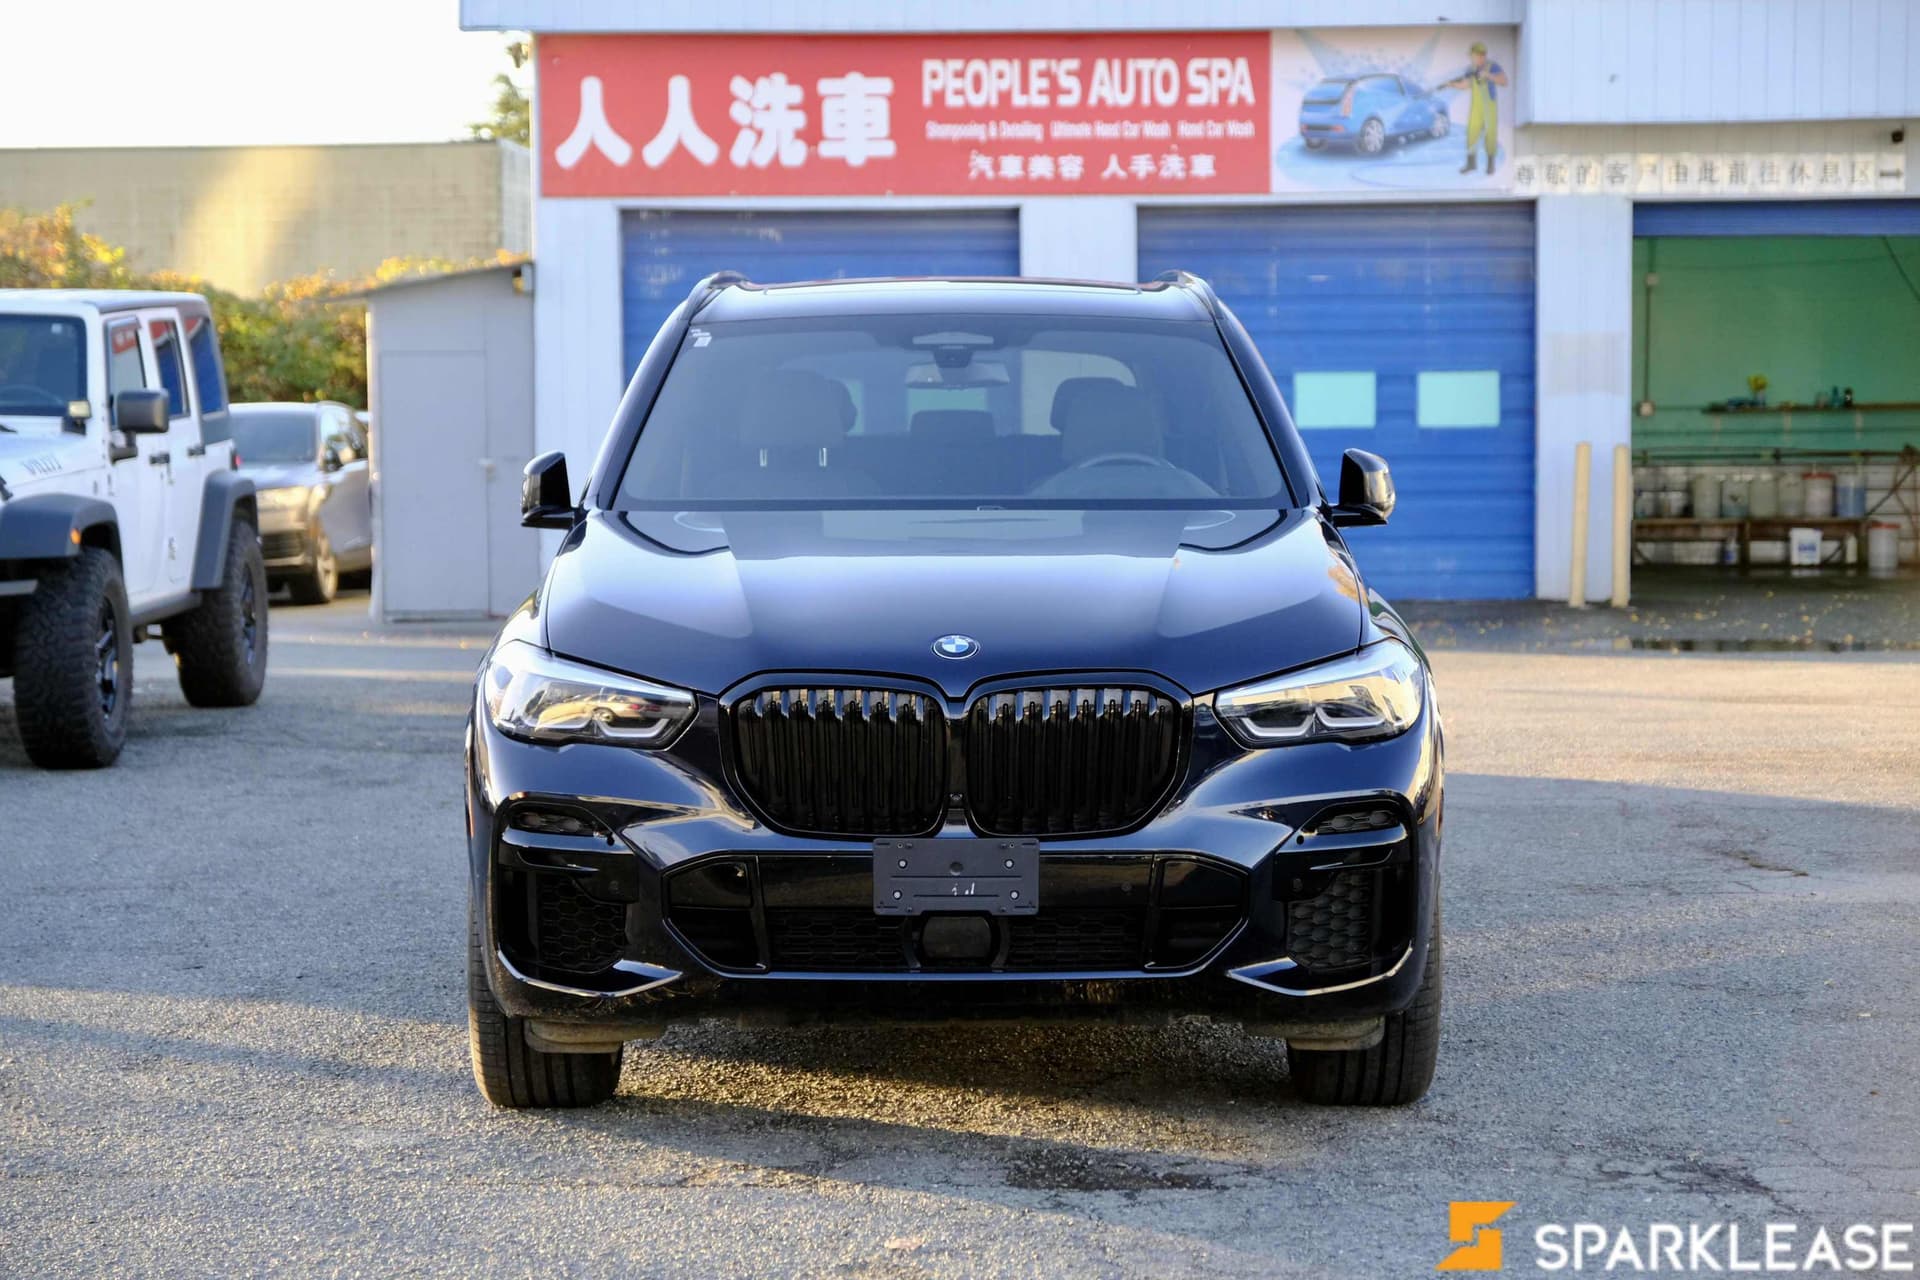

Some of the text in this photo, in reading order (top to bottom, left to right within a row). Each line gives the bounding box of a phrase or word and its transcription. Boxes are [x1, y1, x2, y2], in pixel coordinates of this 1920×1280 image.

[922, 57, 1256, 107] PEOPLE'S AUTO SPA
[555, 73, 896, 169] 人人洗車
[1123, 120, 1141, 139] Car
[1143, 120, 1171, 139] Wash
[1207, 120, 1225, 139] Car
[1226, 120, 1256, 139] Wash
[968, 151, 1217, 180] 汽車美容 人手洗車
